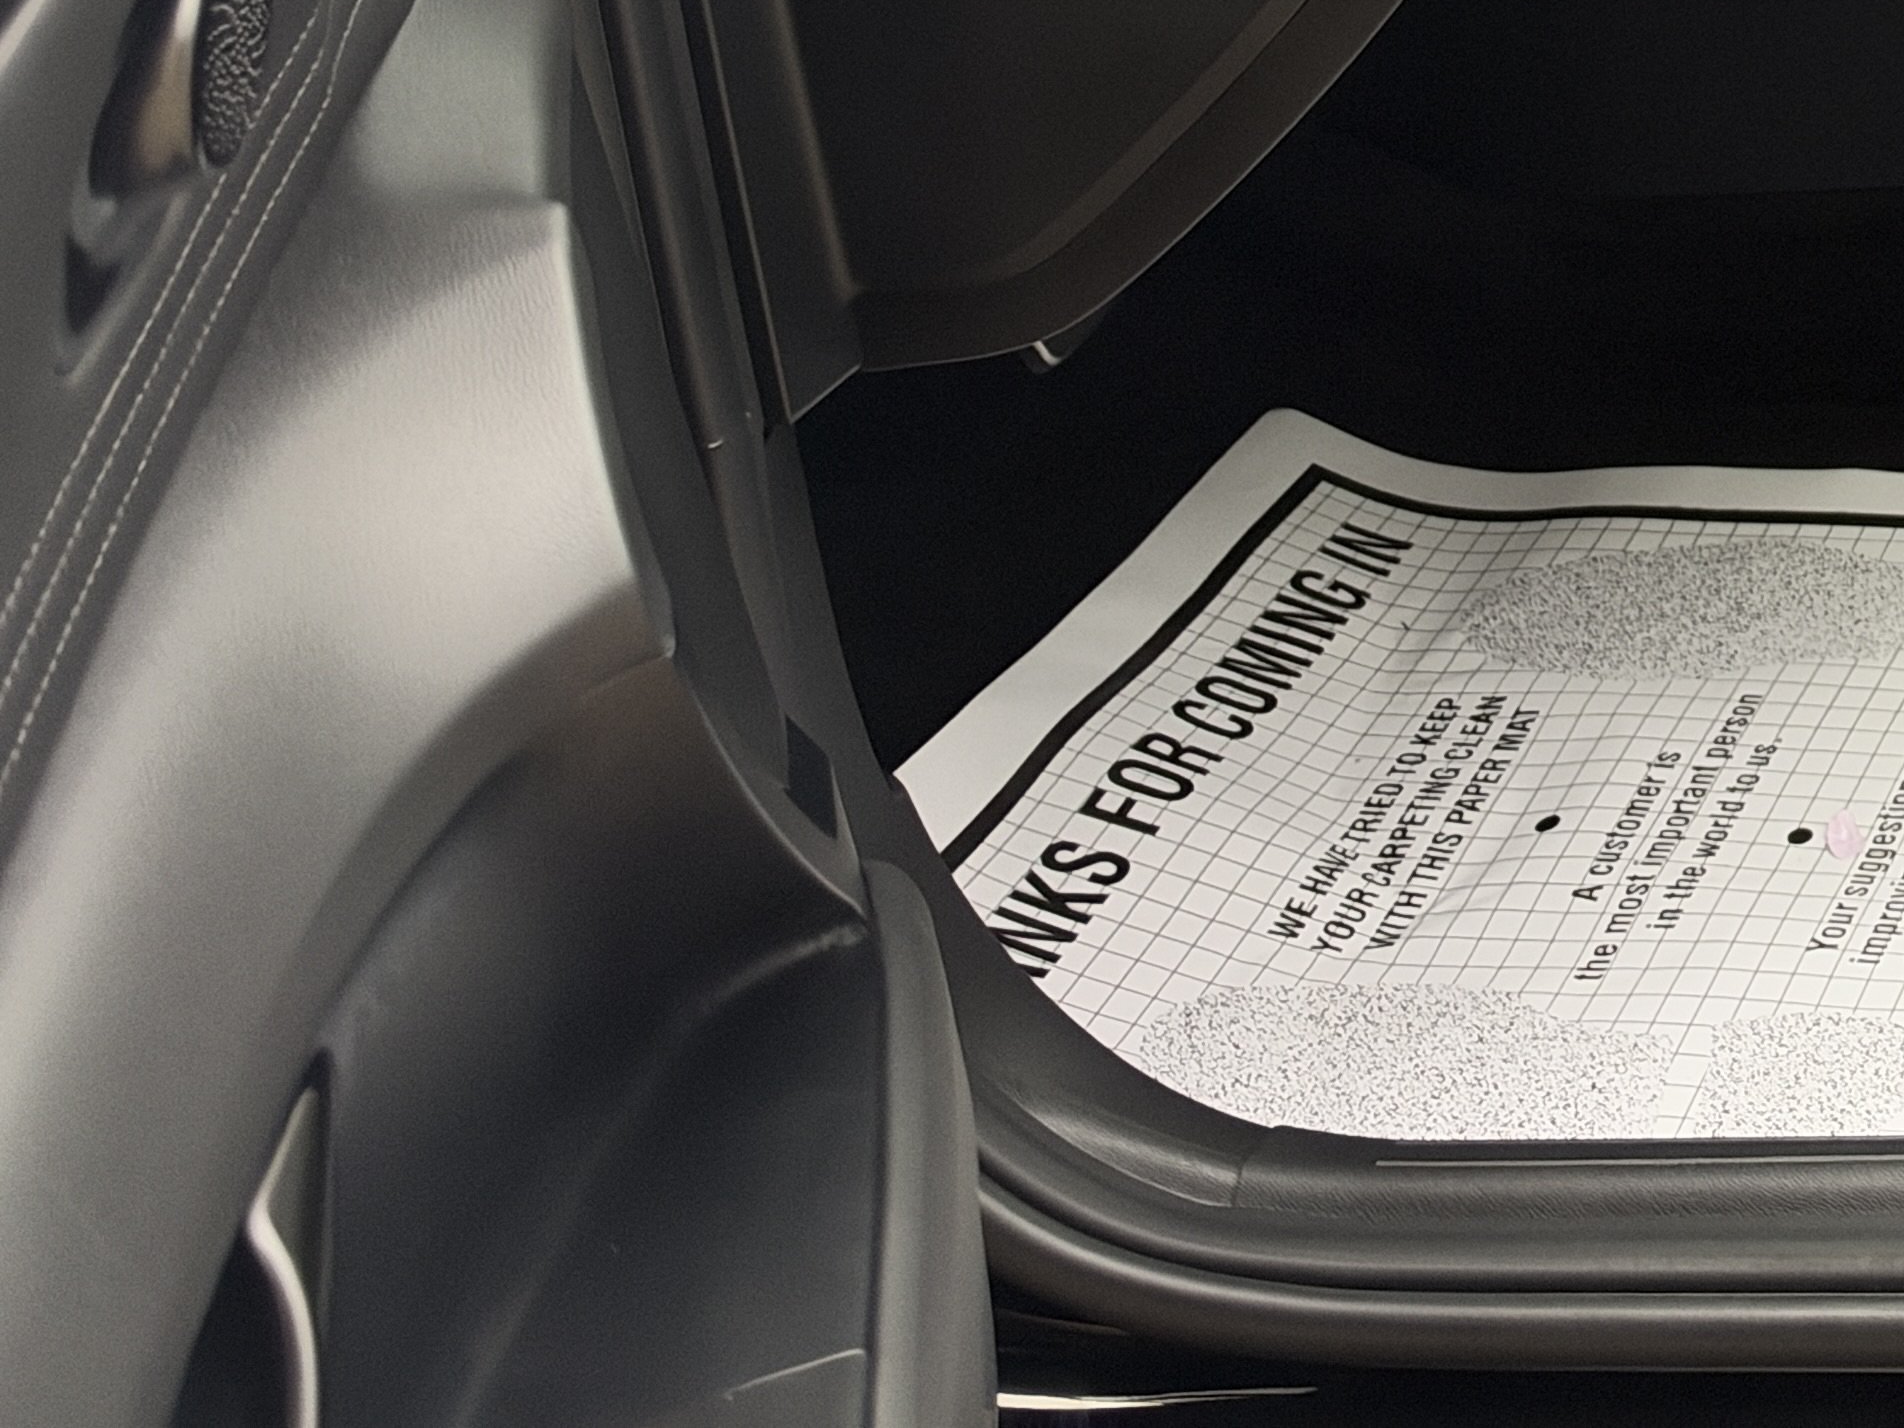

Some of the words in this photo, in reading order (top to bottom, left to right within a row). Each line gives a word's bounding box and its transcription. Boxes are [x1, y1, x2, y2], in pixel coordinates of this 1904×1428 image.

[988, 840, 1130, 978] NKS
[1080, 732, 1223, 836] FOR
[1172, 569, 1371, 740] COMING
[1321, 521, 1414, 578] IN
[1726, 773, 1760, 793] to
[1746, 737, 1783, 767] us.
[1267, 897, 1318, 940] WE
[1300, 843, 1359, 896] HAVE
[1340, 783, 1404, 844] TRIED
[1387, 752, 1427, 777] TO
[1410, 697, 1461, 747] KEEP
[1310, 887, 1379, 953] YOUR
[1361, 767, 1461, 887] CARPETING
[1444, 695, 1507, 760] CLEAN
[1364, 890, 1428, 950] WITH
[1407, 831, 1464, 884] THIS
[1445, 757, 1512, 825] PAPER
[1492, 706, 1540, 752] MAT
[1571, 885, 1604, 901] A
[1589, 774, 1666, 876] customer
[1647, 751, 1682, 769] is
[1574, 943, 1618, 980] the
[1605, 873, 1656, 934] most
[1633, 765, 1720, 866] important
[1706, 693, 1764, 759] person
[1692, 799, 1746, 859] world
[1646, 908, 1684, 930] in
[1663, 866, 1707, 900] the
[1805, 902, 1859, 953] Your
